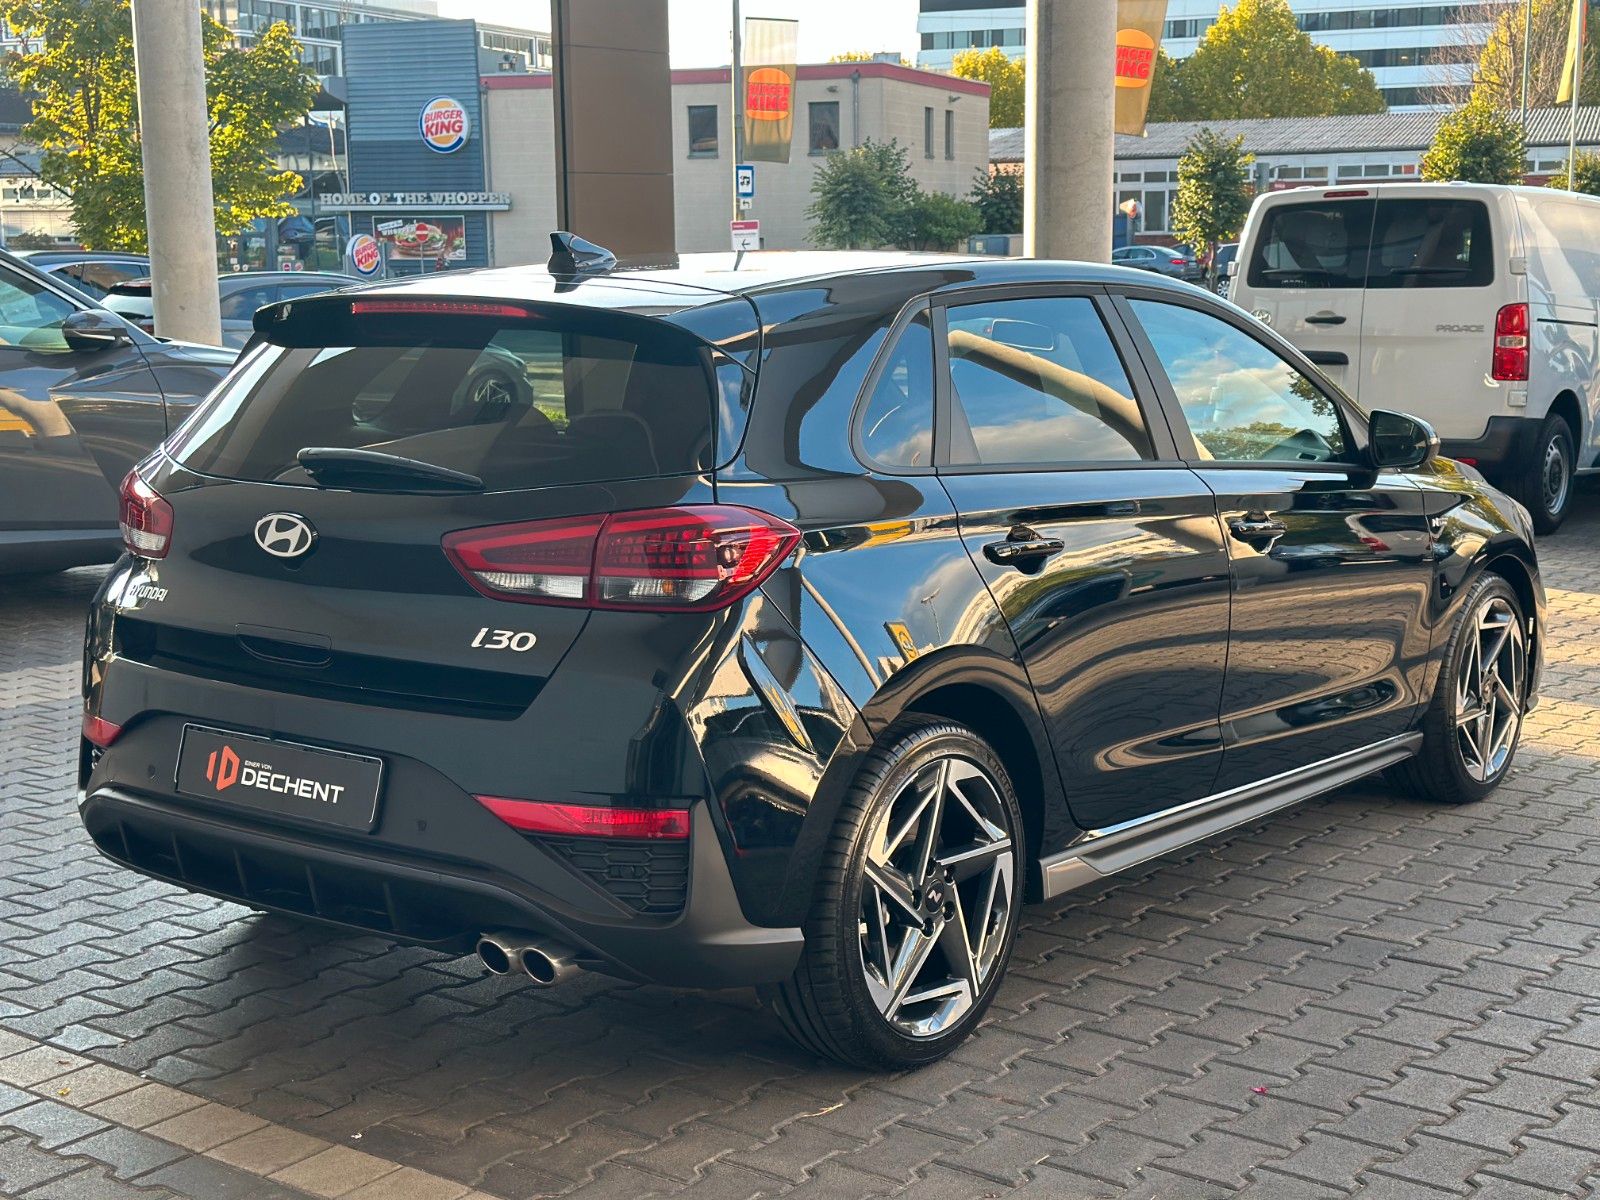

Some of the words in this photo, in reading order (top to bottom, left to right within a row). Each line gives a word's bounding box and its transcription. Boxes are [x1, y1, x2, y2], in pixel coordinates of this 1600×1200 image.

[1116, 60, 1151, 79] ING
[748, 95, 789, 111] KING
[424, 109, 463, 124] BURGER
[425, 120, 463, 138] KING
[319, 192, 366, 205] HOME
[369, 192, 391, 205] OF
[393, 192, 427, 205] THE
[430, 192, 511, 205] WHOPPER
[355, 241, 377, 257] BURGER
[357, 250, 378, 267] KING
[130, 584, 169, 602] HYUNDAI
[244, 760, 260, 768] EINER
[261, 763, 273, 771] VON
[241, 767, 345, 804] DECHENT
